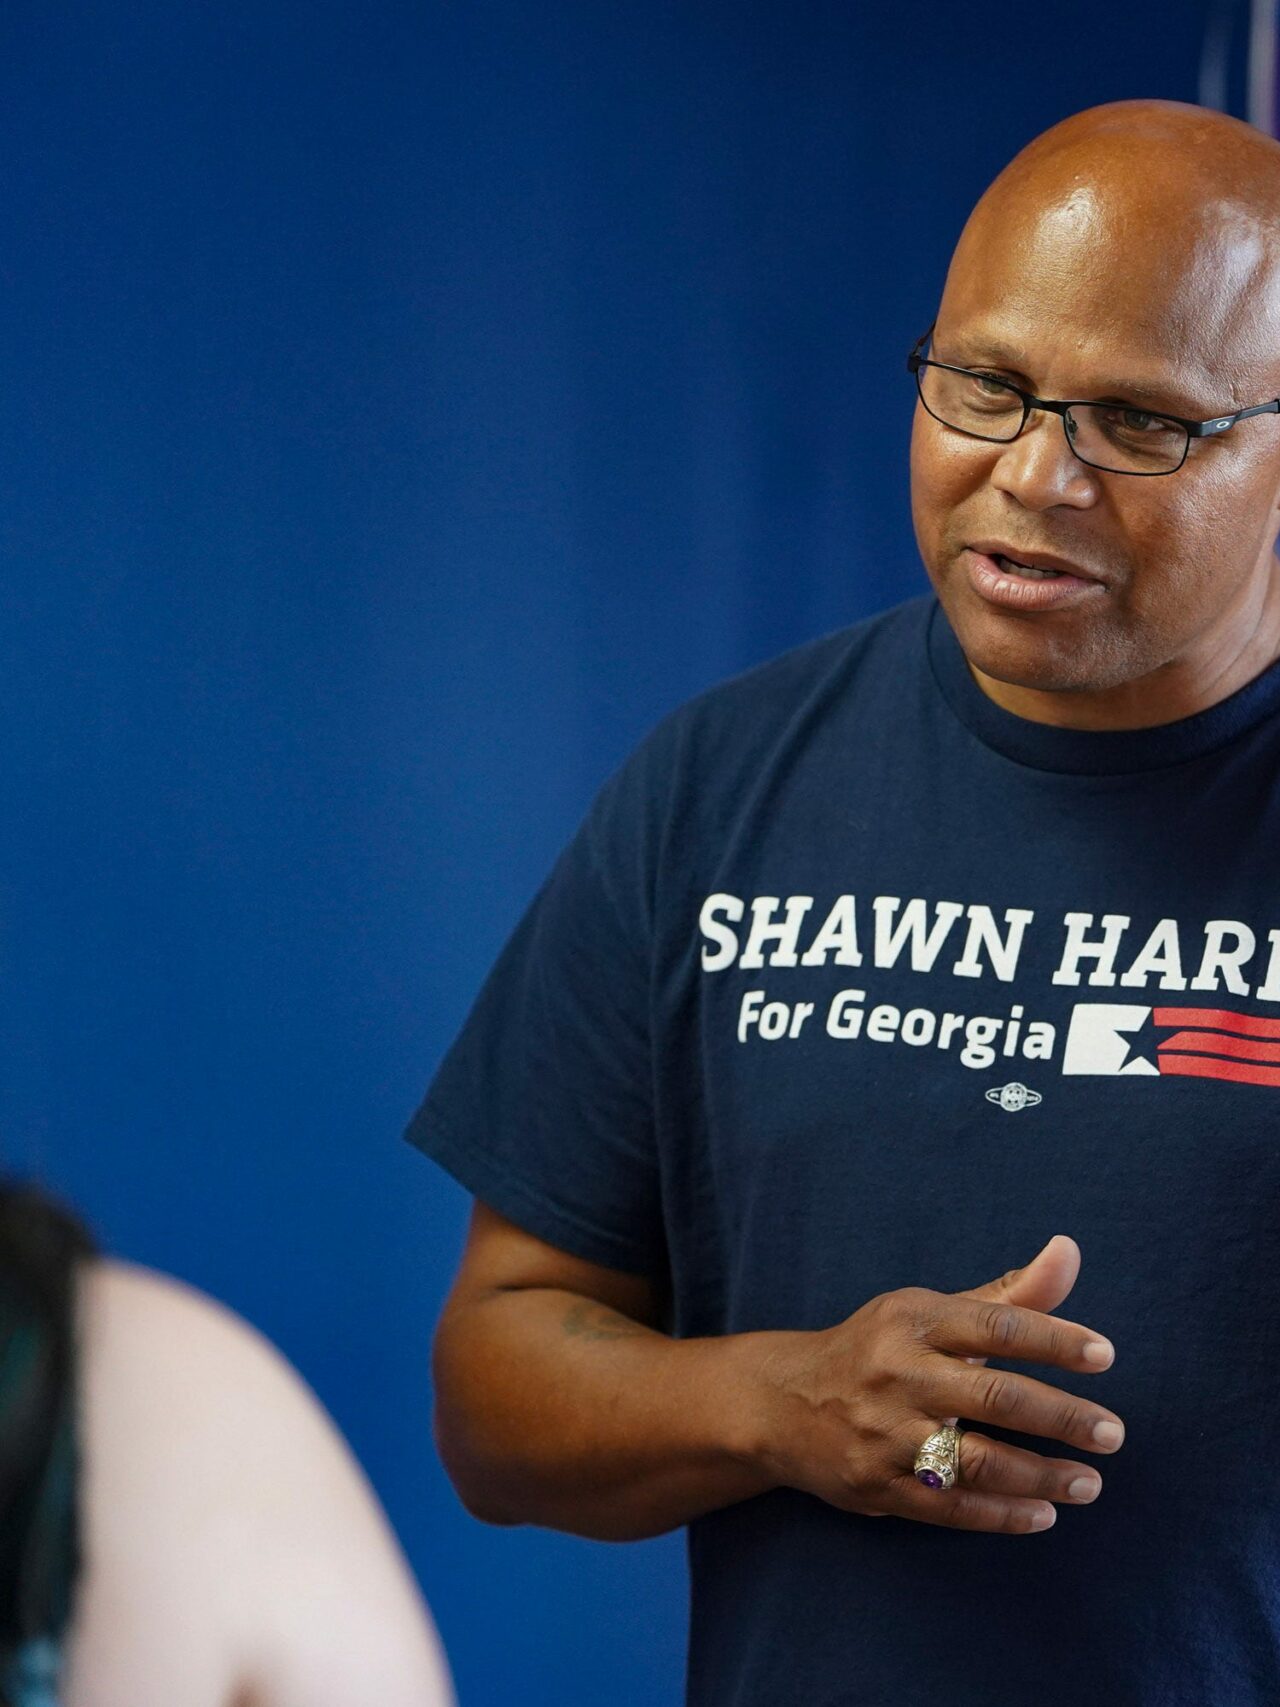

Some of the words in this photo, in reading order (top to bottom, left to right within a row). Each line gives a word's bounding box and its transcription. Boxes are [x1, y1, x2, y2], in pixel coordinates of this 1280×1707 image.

[699, 893, 1034, 982] SHAWN
[737, 990, 815, 1043] For
[826, 988, 1056, 1069] Georgia
